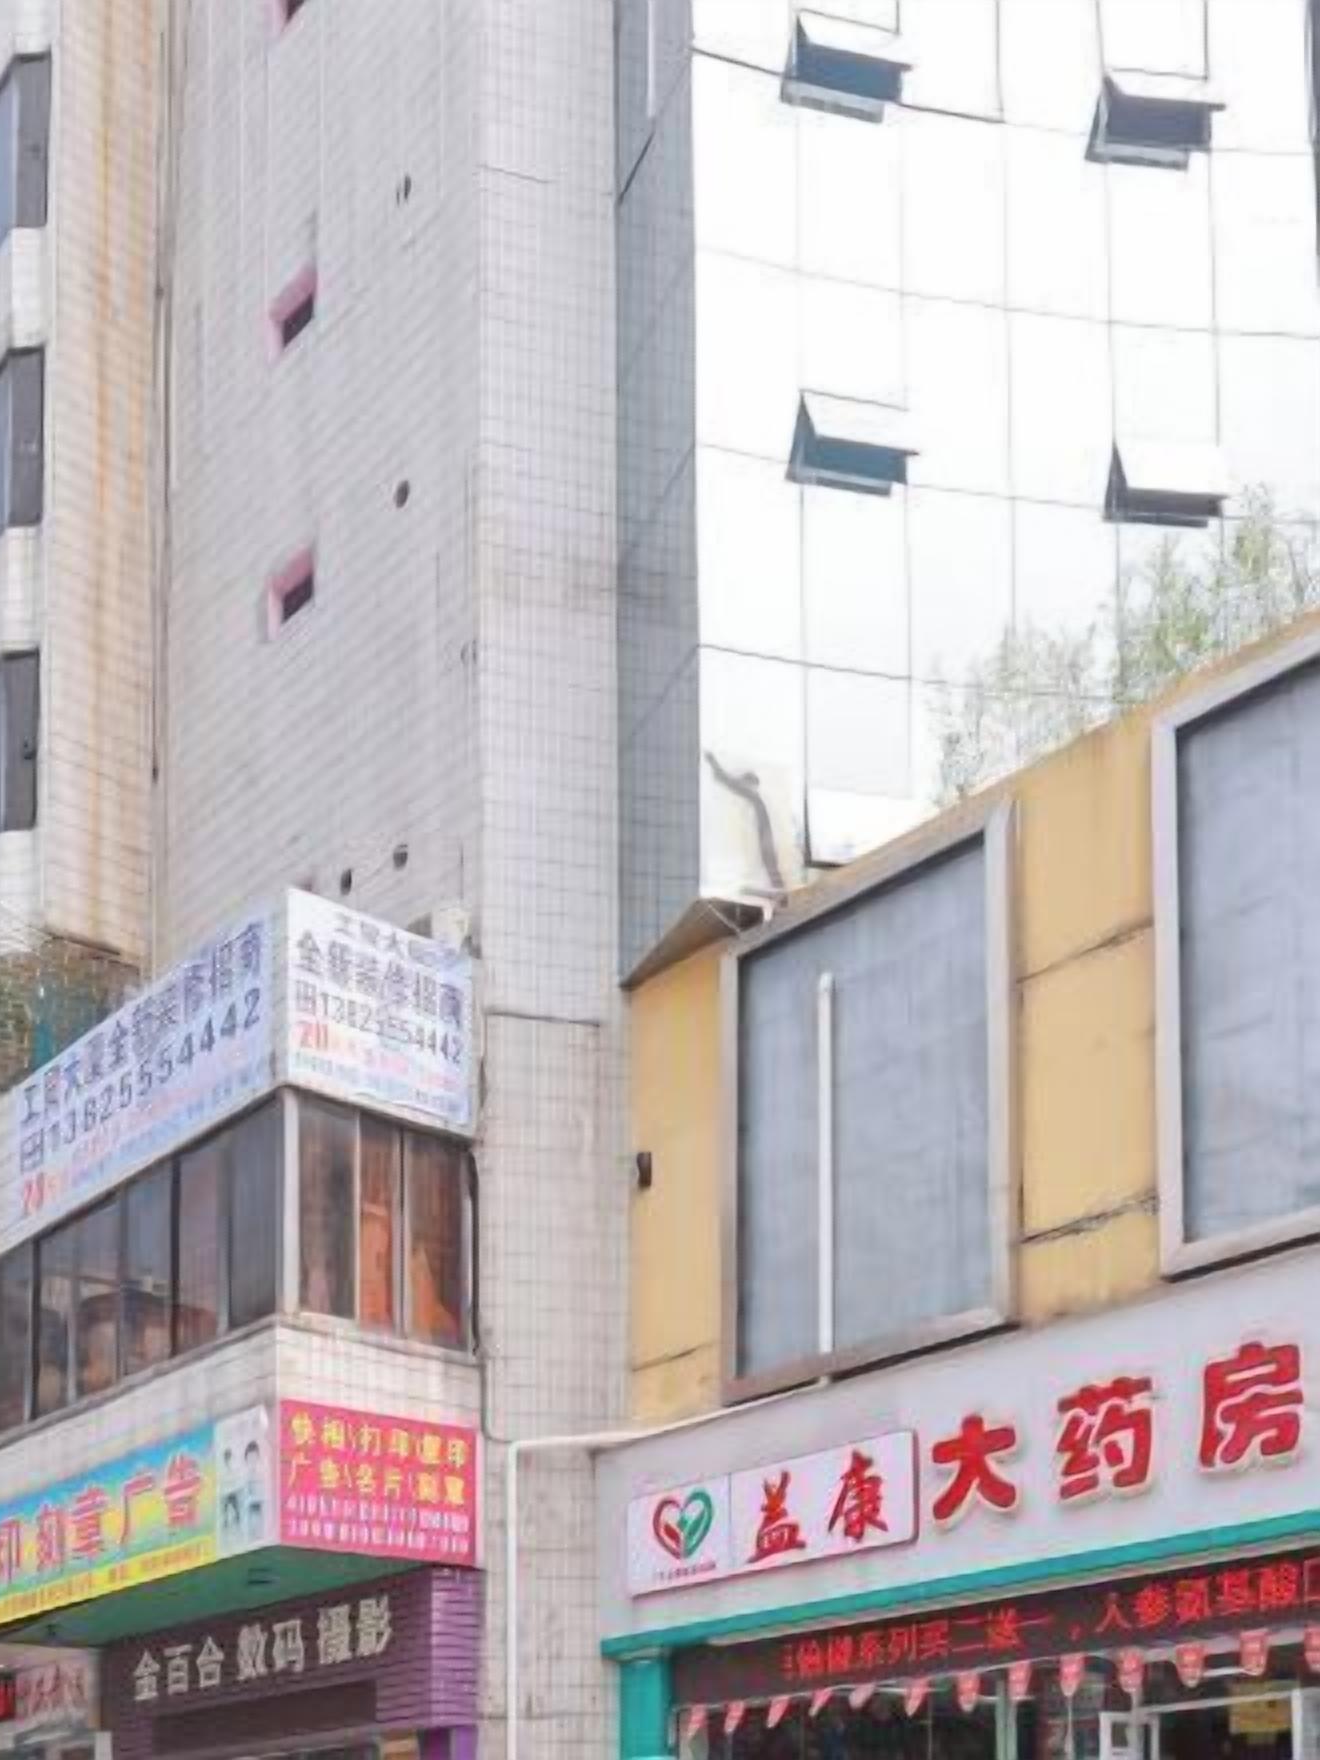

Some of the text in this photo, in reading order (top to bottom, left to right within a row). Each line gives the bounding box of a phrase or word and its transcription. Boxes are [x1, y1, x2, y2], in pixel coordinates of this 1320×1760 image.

[748, 1341, 1304, 1563] 益康 大药房
